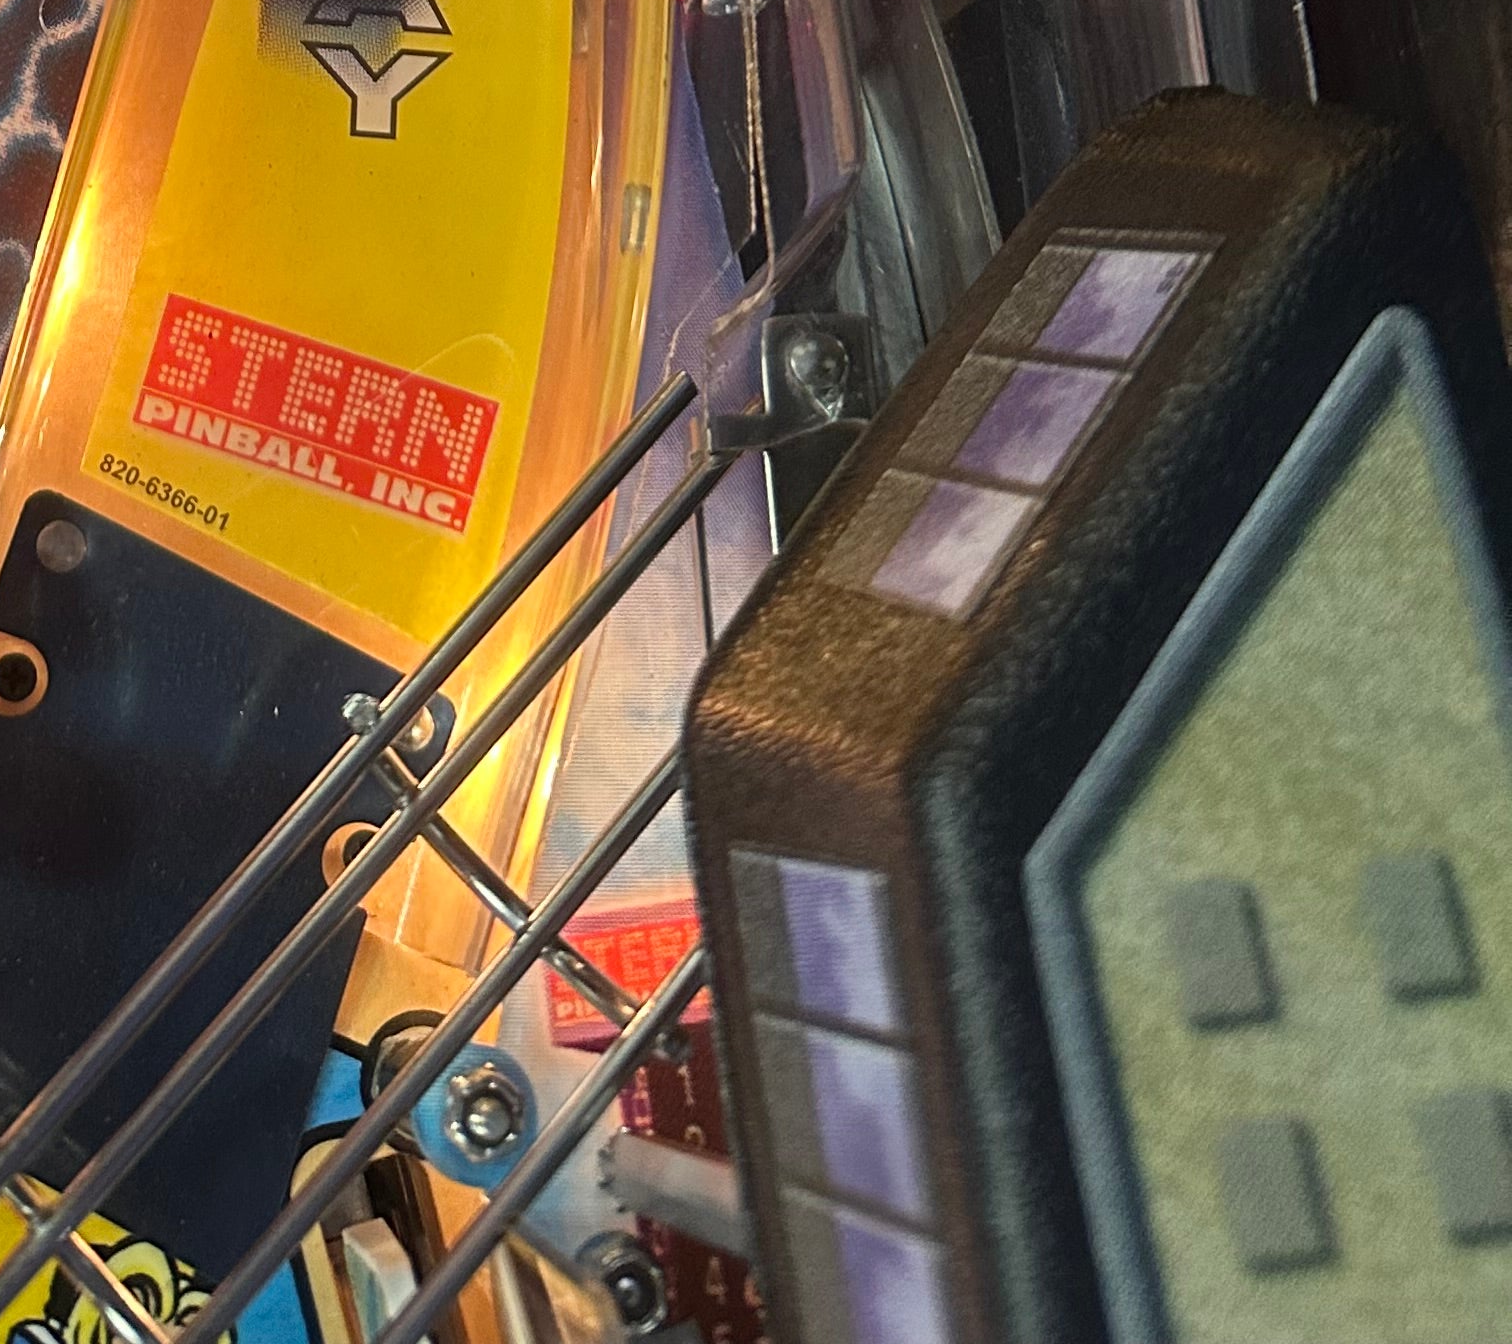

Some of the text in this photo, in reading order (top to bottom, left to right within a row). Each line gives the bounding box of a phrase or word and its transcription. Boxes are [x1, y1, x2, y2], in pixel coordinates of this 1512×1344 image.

[139, 392, 465, 529] PINBALL, INC.
[156, 308, 484, 485] STERN
[99, 452, 231, 532] 820-6366-01
